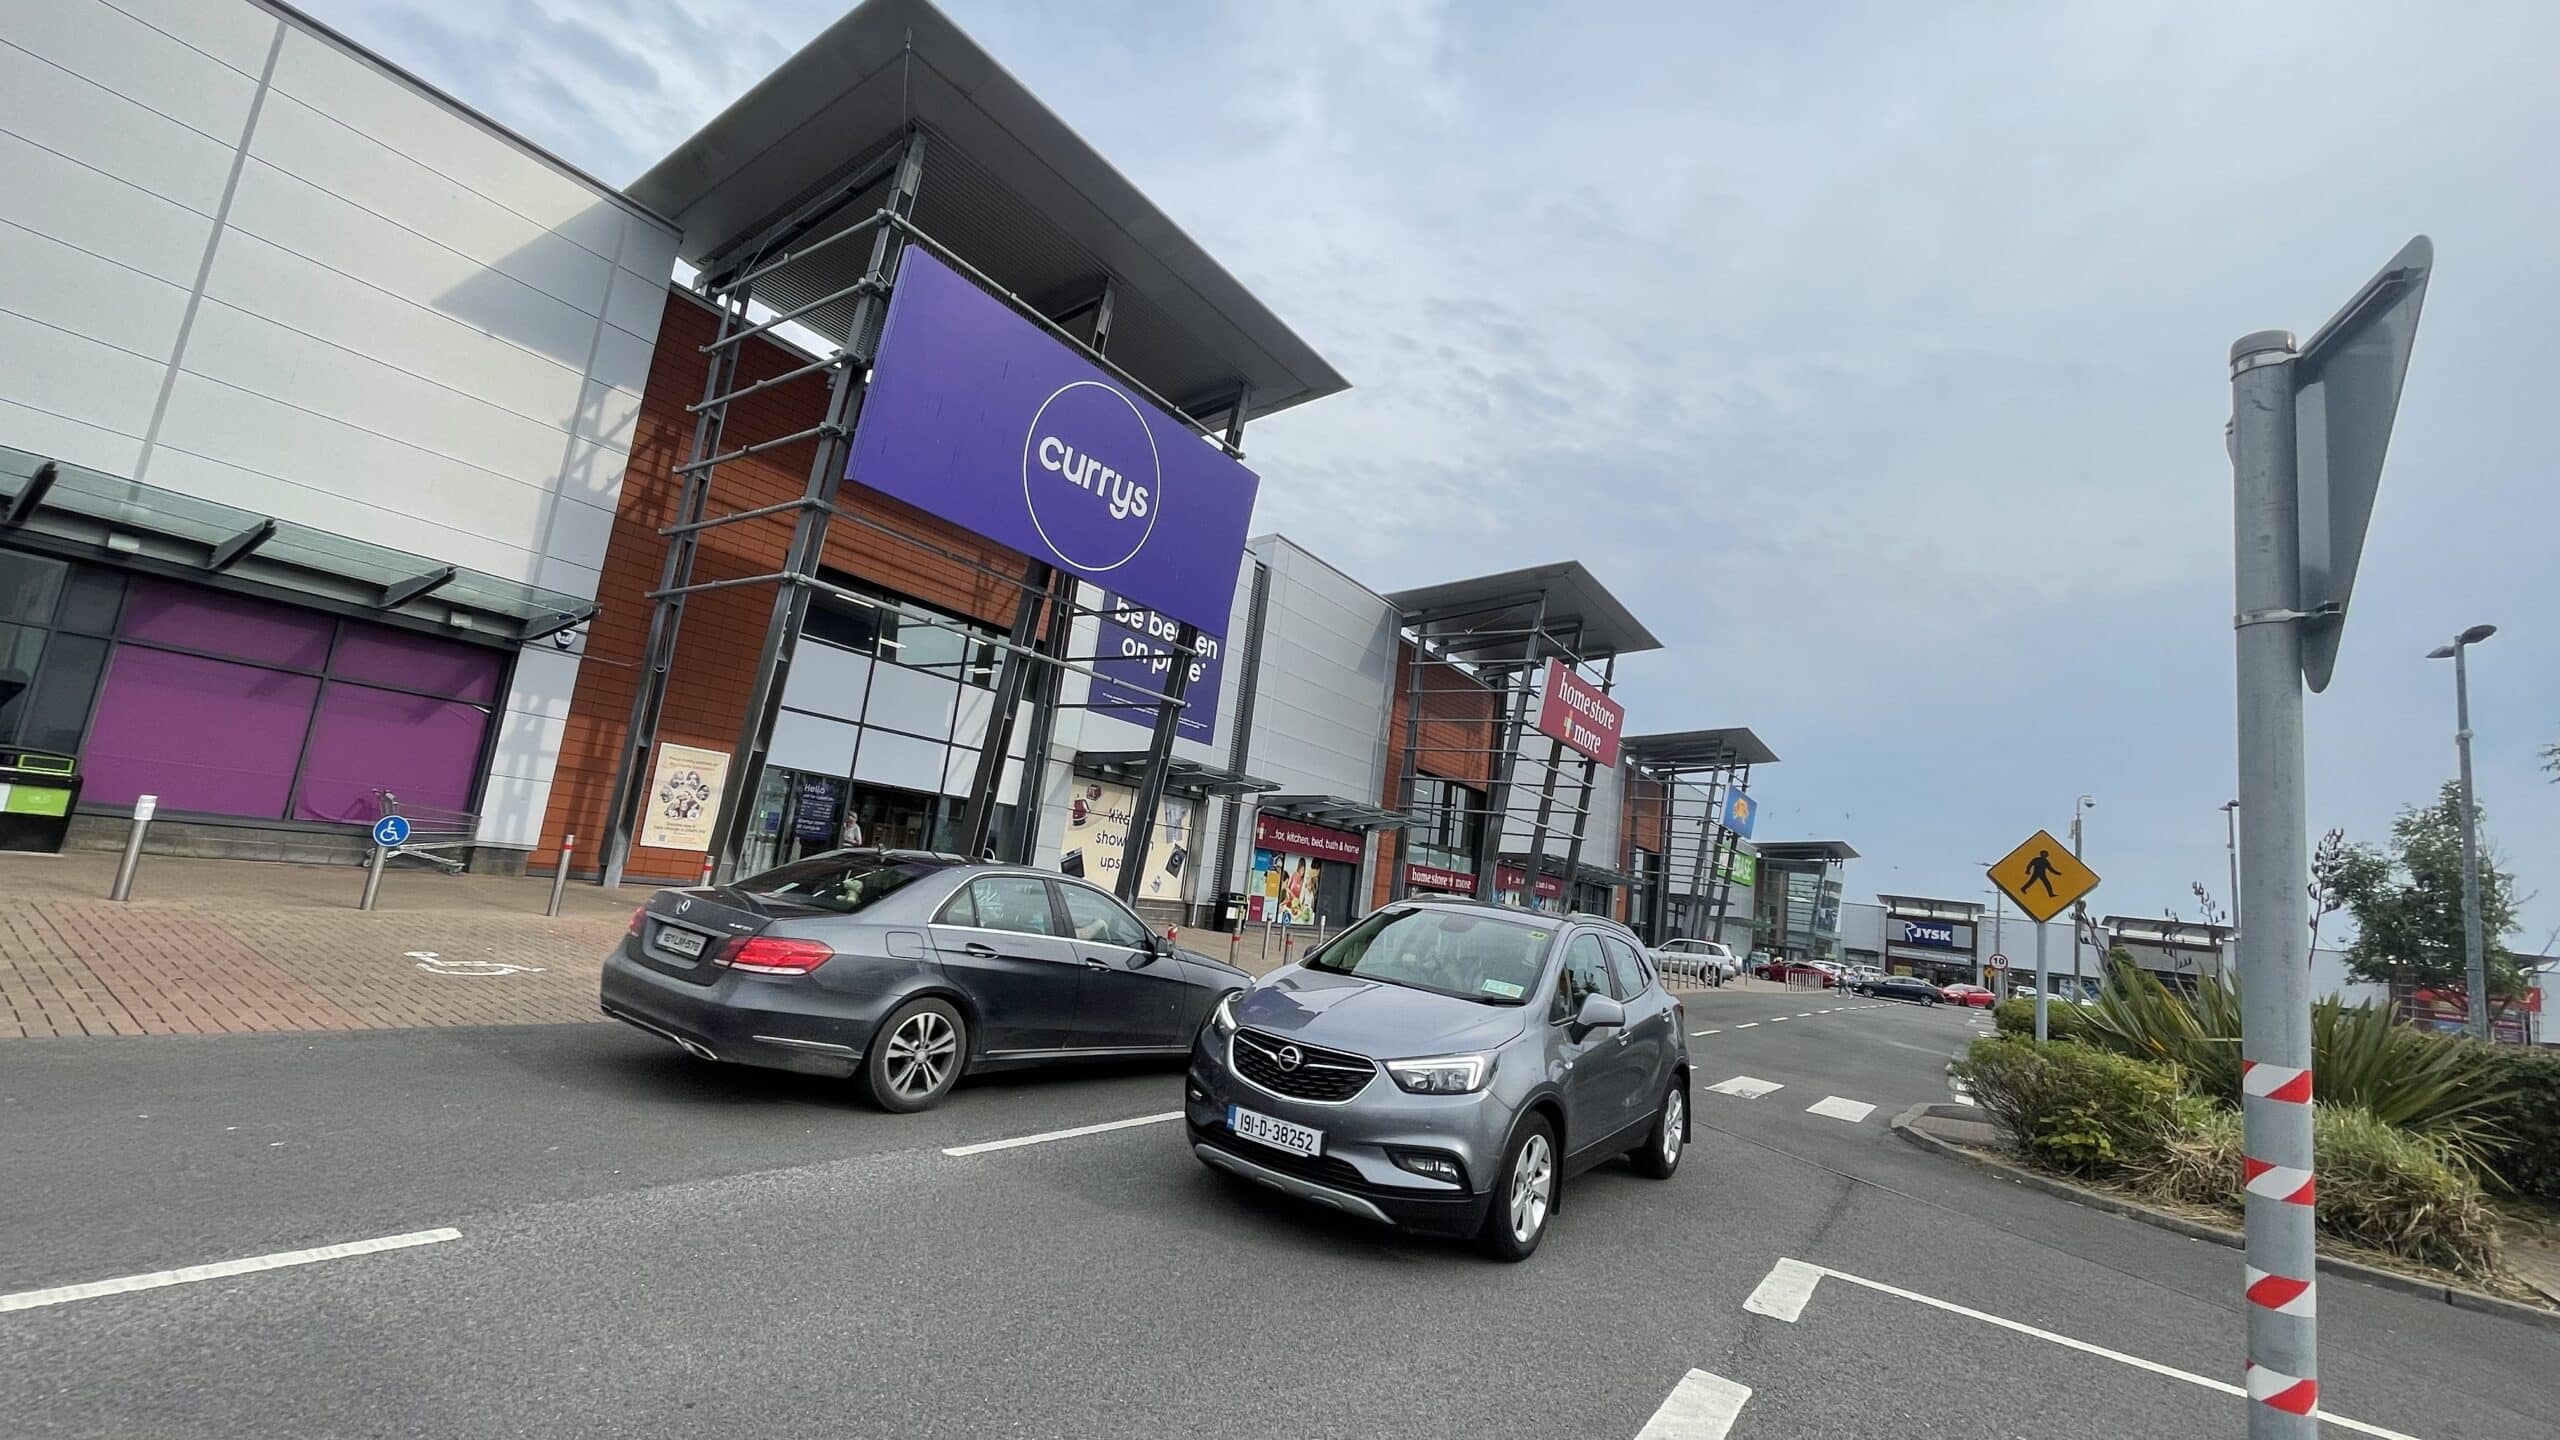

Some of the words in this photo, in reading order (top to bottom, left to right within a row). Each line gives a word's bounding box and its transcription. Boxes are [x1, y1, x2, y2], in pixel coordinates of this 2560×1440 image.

[1039, 436, 1149, 520] currys
[1114, 597, 1144, 629] be
[1149, 611, 1218, 660] been
[1122, 638, 1148, 664] on
[1573, 724, 1601, 755] more
[804, 783, 825, 794] Hello
[1455, 878, 1471, 890] more
[1914, 927, 1952, 941] JYSK
[1994, 957, 2005, 965] 10
[1240, 1112, 1314, 1152] 191-D-38252
